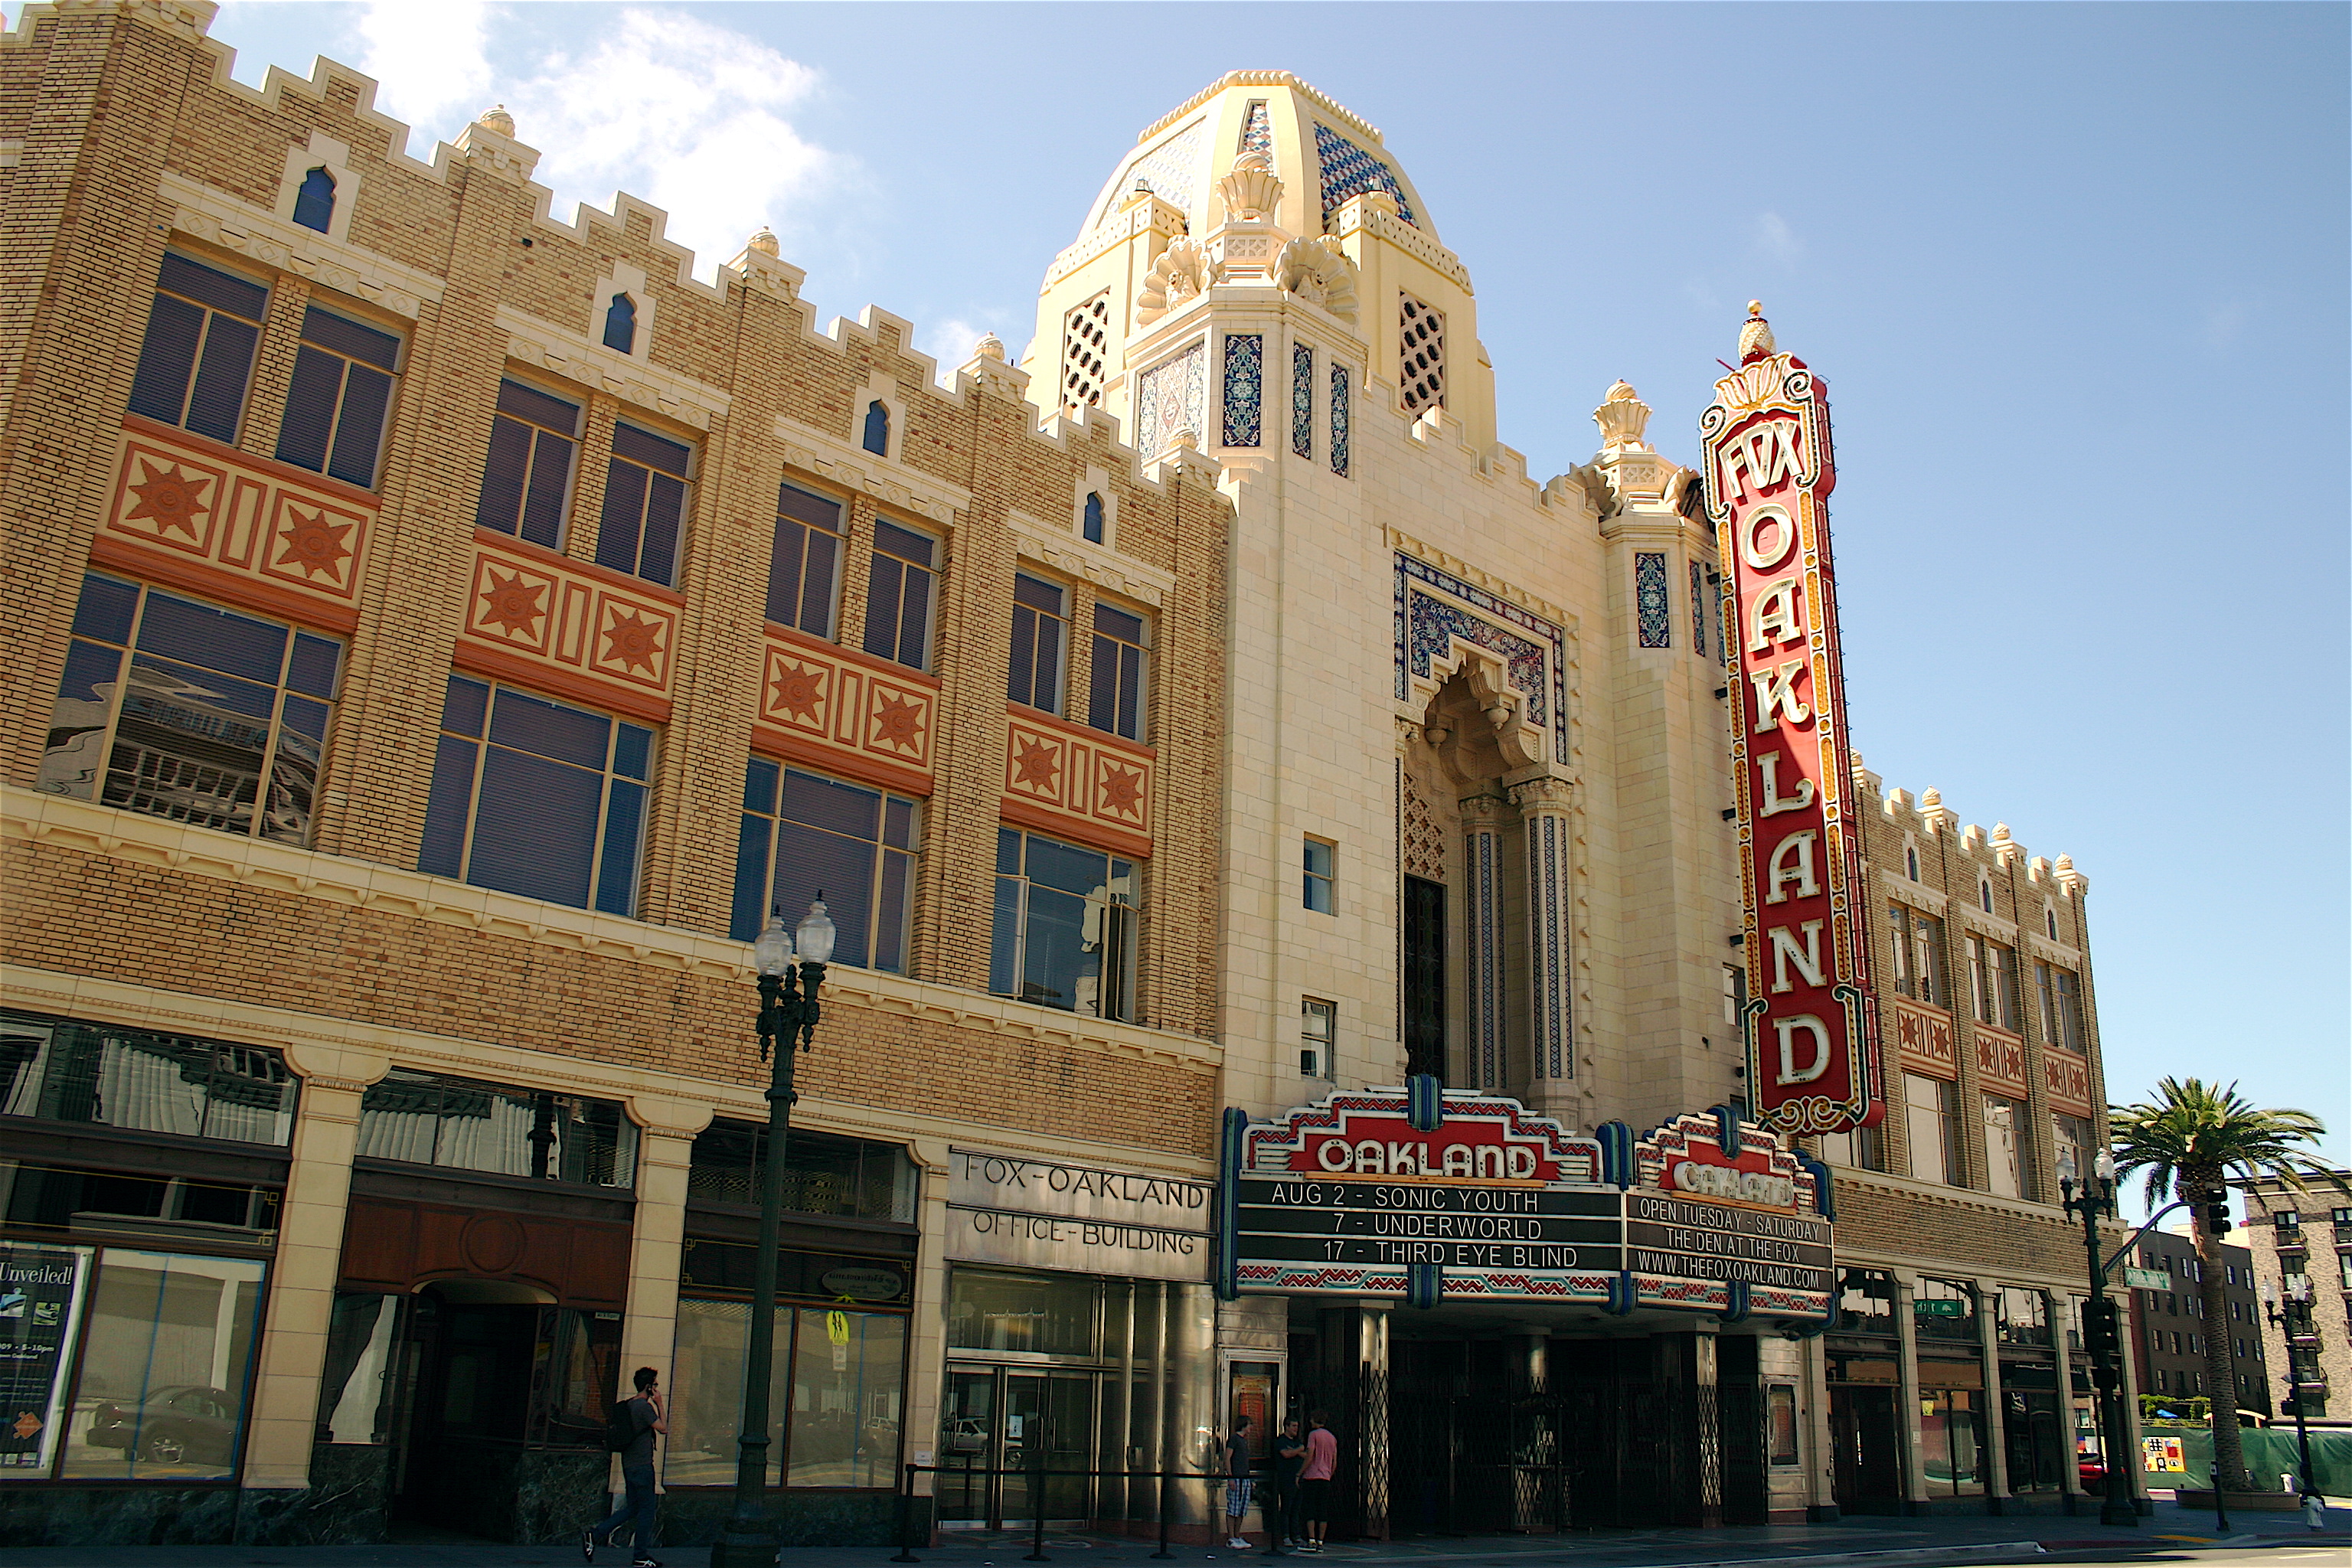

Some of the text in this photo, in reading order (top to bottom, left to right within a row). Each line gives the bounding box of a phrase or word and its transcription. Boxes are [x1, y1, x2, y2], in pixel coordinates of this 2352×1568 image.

[1718, 420, 1802, 499] FOX
[1740, 501, 1833, 1087] OAKLAND
[1317, 1138, 1537, 1179] OAKLAND
[1272, 1183, 1322, 1204] AUG
[1333, 1185, 1345, 1205] 2
[1375, 1187, 1446, 1210] SONIC
[1458, 1189, 1538, 1213] YOUTH
[1674, 1161, 1795, 1207] OAKLAND
[1334, 1213, 1344, 1233] 7
[1375, 1214, 1542, 1240] UNDERWORLD
[1640, 1198, 1677, 1221] OPEN
[1681, 1204, 1742, 1230] TUESDAY
[1756, 1215, 1820, 1240] SATURDAY
[1324, 1240, 1345, 1261] 17
[1376, 1241, 1446, 1264] THIRD
[1456, 1245, 1502, 1266] EYE
[1514, 1246, 1577, 1268] BLIND
[1666, 1227, 1800, 1263] THE DEN AT THE FOX
[1638, 1251, 1820, 1289] WWW.THEFOXOAKLAND.COM
